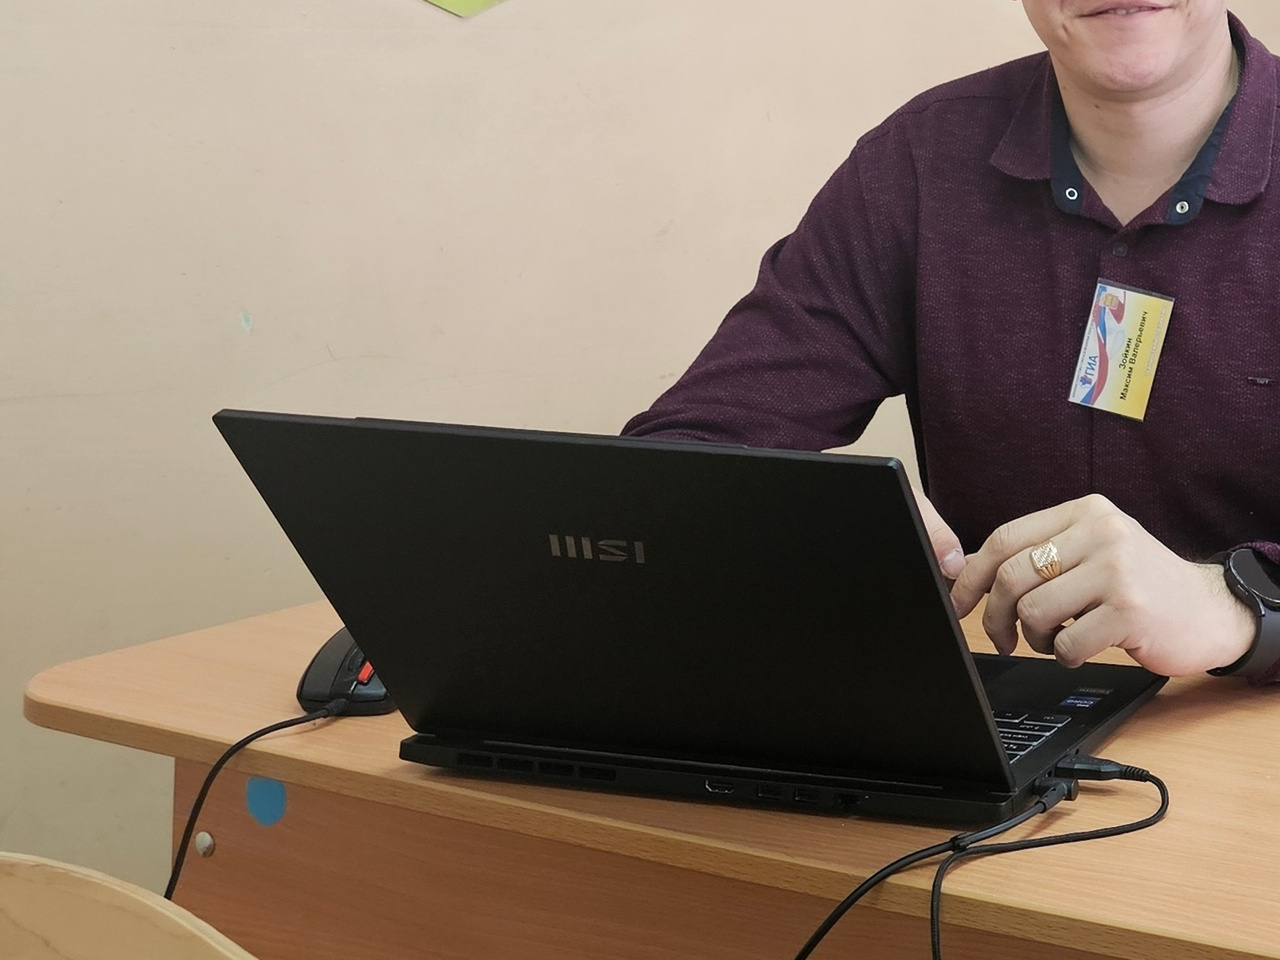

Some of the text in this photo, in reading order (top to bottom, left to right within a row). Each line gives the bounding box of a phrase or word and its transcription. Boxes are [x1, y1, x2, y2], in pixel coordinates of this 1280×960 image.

[1085, 354, 1099, 377] ГИА
[1118, 337, 1133, 370] Зойкин
[1119, 310, 1149, 401] Максим Валерьевич
